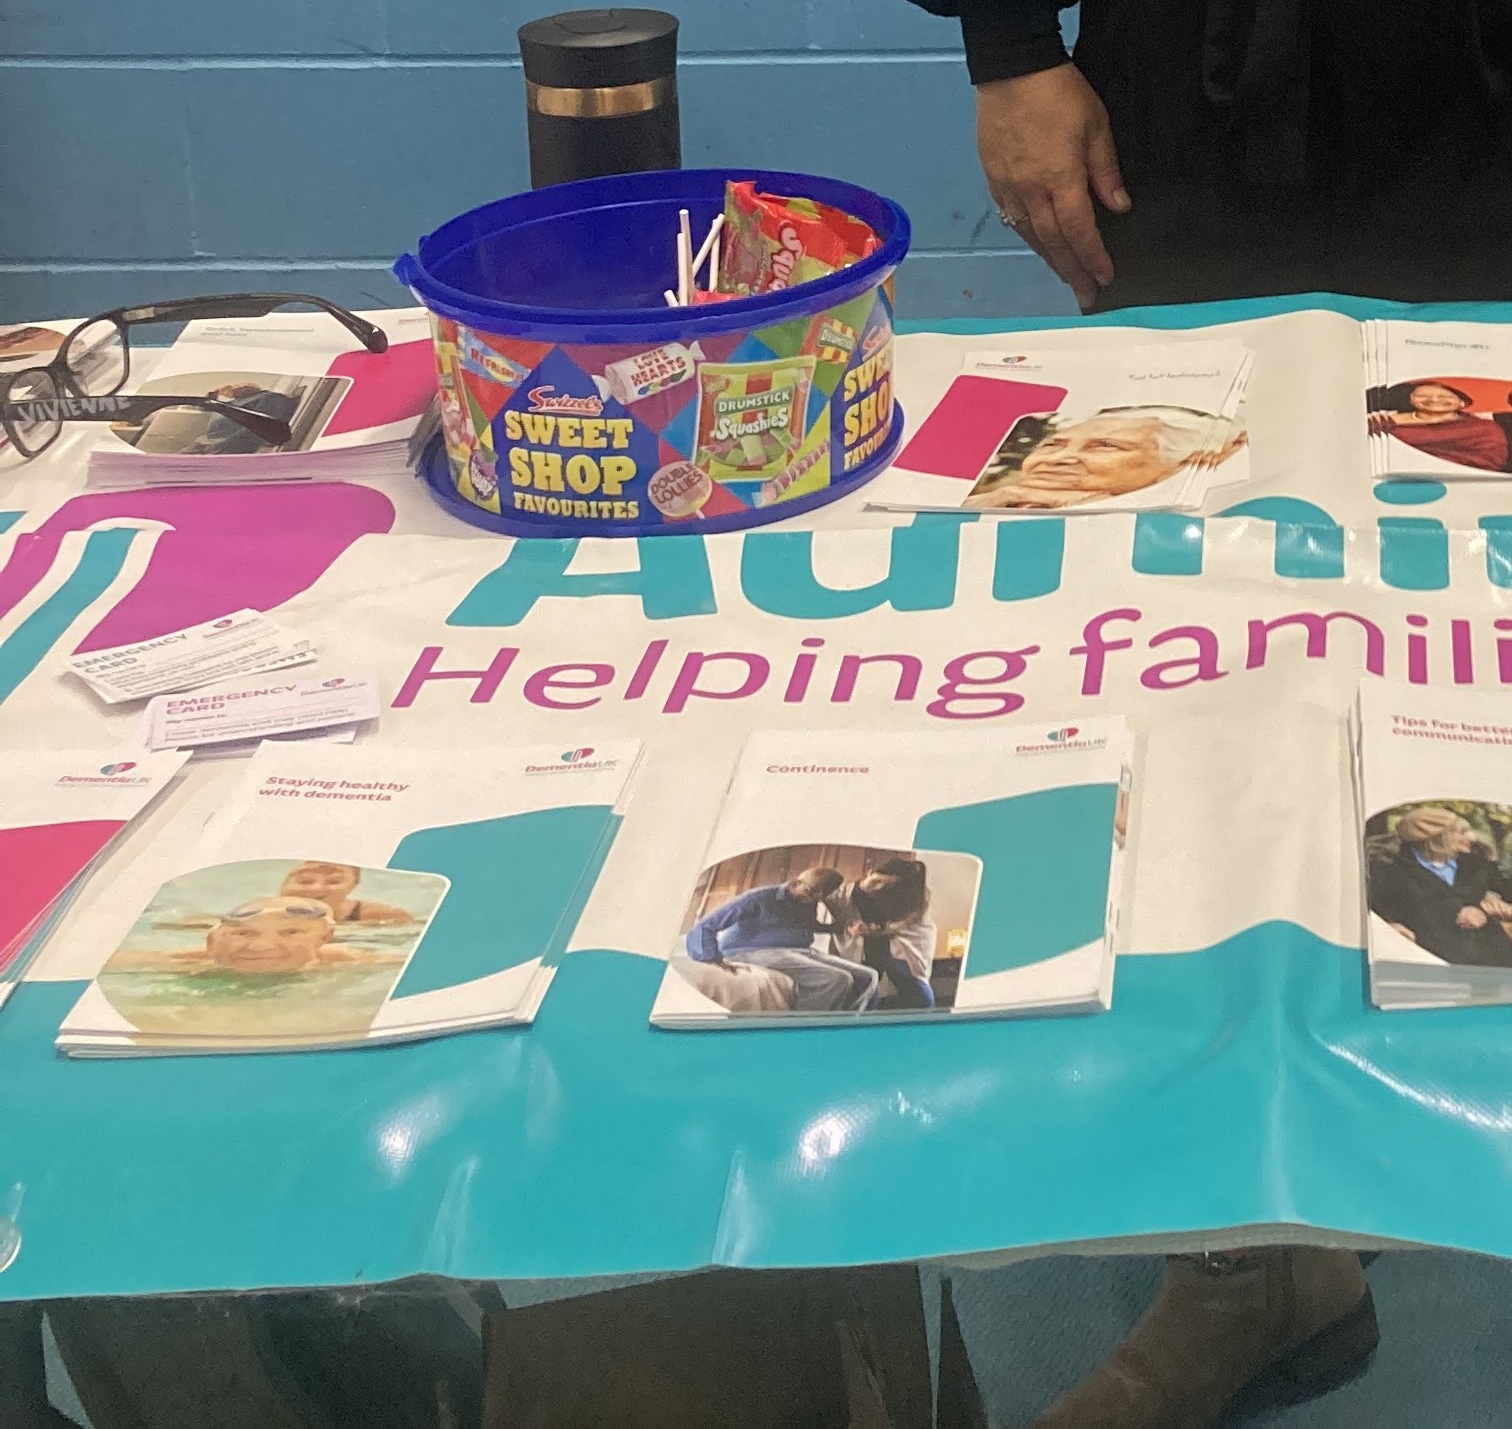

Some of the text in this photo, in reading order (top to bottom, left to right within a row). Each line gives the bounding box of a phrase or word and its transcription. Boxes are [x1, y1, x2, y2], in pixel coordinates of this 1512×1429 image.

[630, 356, 687, 387] HEARTS
[633, 348, 669, 369] LOVE
[718, 389, 790, 413] DRUMSTICK
[844, 381, 890, 446] SHO
[504, 410, 634, 450] SWEET
[712, 406, 789, 440] Squashies
[508, 447, 638, 496] SHOP
[651, 460, 698, 495] DOUBLE
[654, 471, 703, 505] LOLLIES
[513, 492, 640, 520] FAVOURITES
[72, 633, 187, 668] EMERGENCY
[84, 657, 138, 674] CARD
[391, 637, 1040, 720] Helping
[165, 684, 297, 708] EMERGENCY
[165, 702, 226, 715] CARD
[1391, 714, 1428, 728] Tips
[1431, 719, 1458, 730] for
[765, 763, 870, 775] Continence
[258, 787, 393, 802] with dementia
[265, 776, 410, 792] Staying healthy
